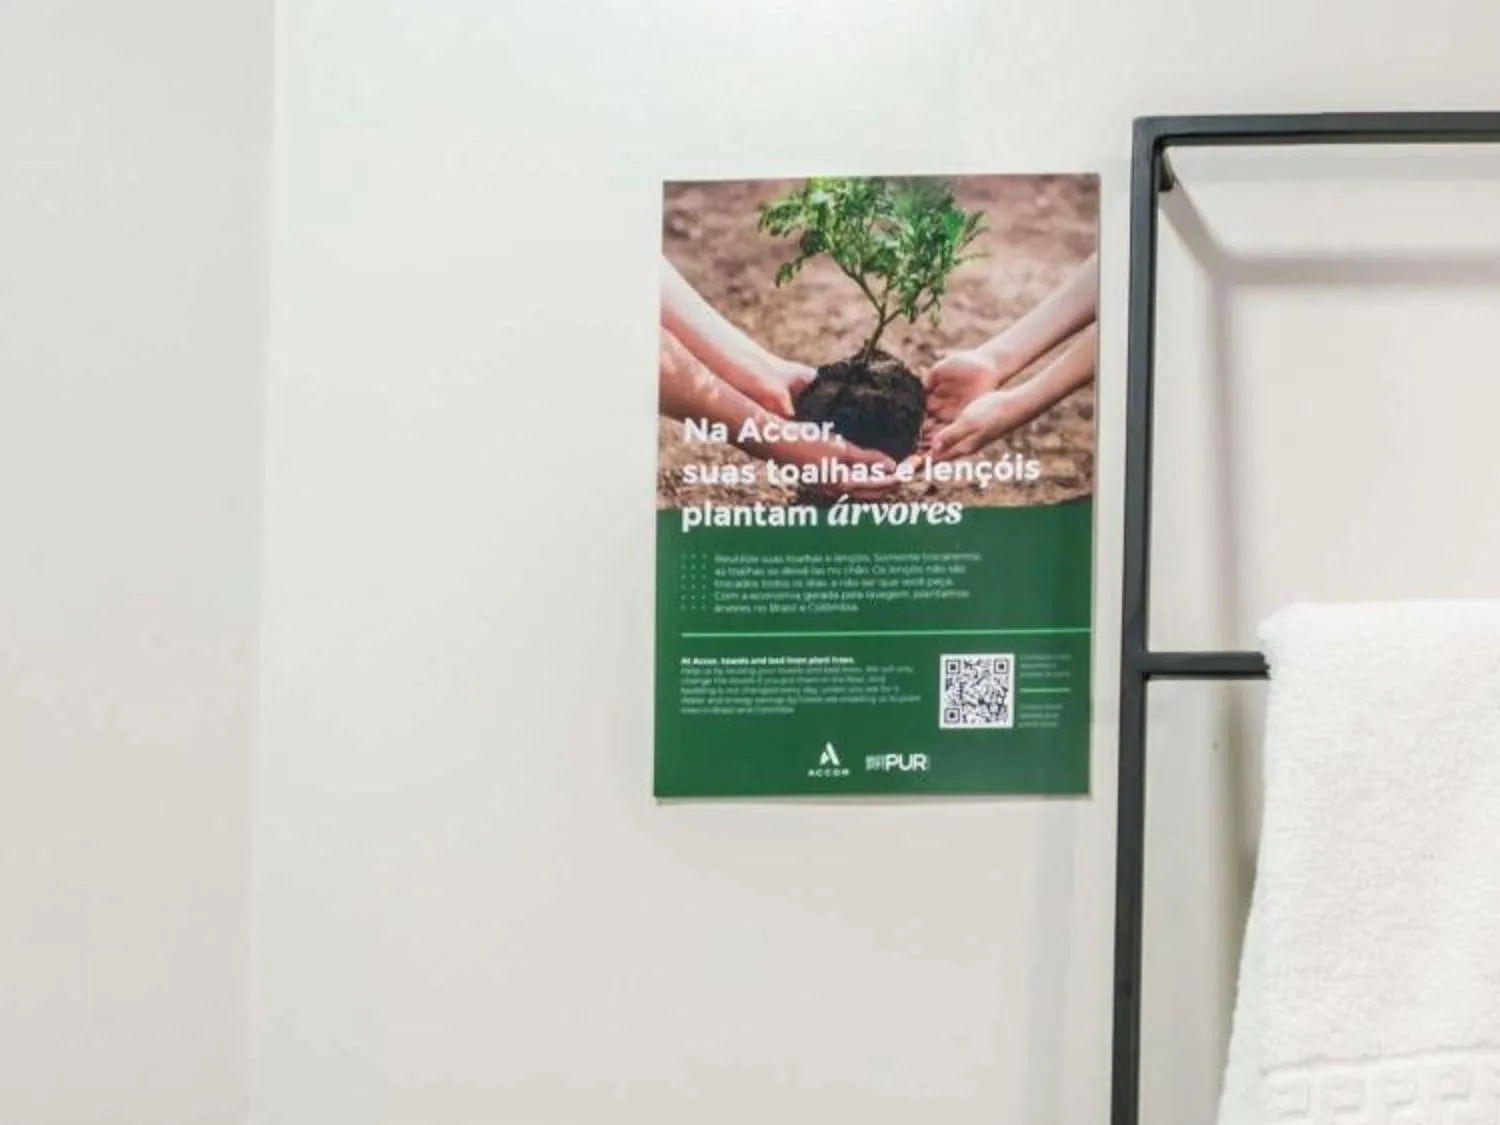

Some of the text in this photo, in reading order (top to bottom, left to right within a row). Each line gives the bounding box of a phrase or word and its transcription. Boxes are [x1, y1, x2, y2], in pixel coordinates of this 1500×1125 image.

[682, 418, 843, 446] Na Accor,
[682, 456, 1041, 489] suas toalhas e lençóis
[681, 494, 963, 532] plantam árvores
[807, 768, 850, 777] ACCOR
[886, 752, 928, 771] PUR
